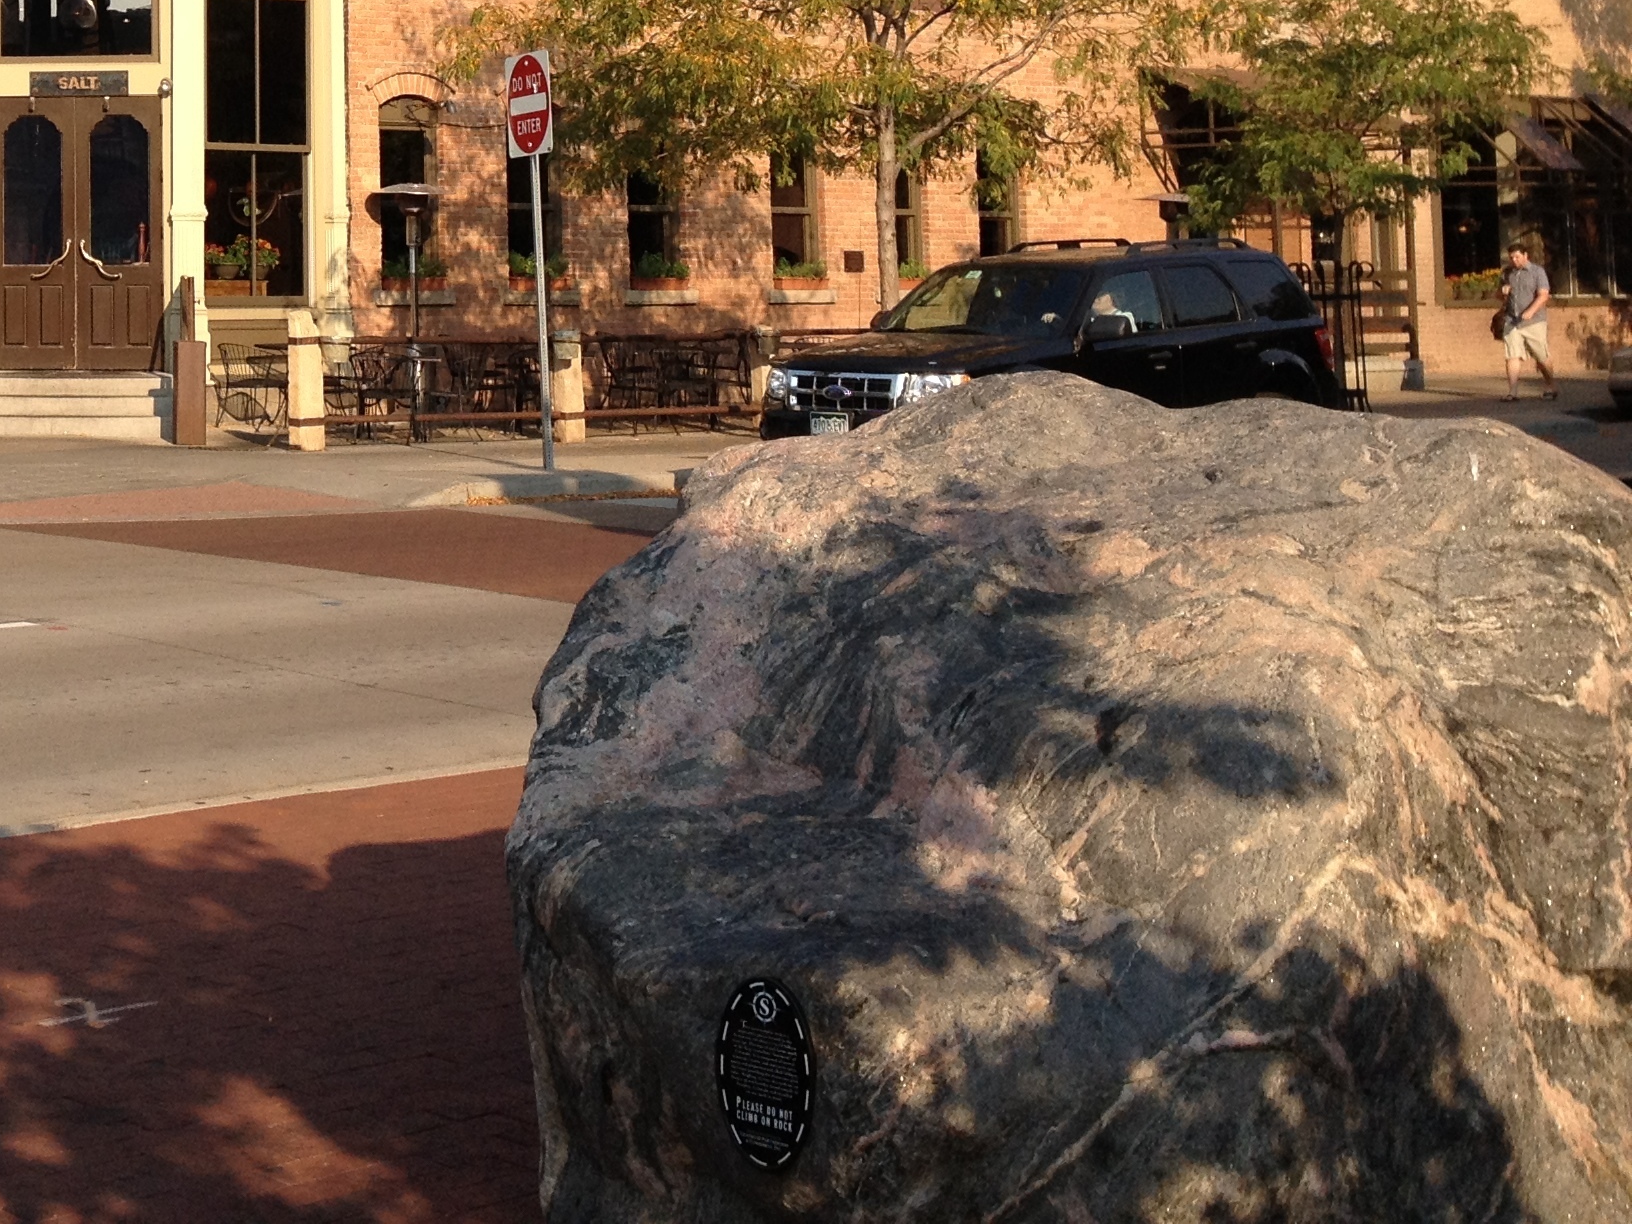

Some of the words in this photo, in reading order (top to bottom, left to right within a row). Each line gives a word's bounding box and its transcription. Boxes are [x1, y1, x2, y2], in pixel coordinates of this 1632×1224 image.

[58, 76, 100, 90] SALT
[512, 76, 523, 92] DO
[526, 72, 542, 90] NOT
[517, 117, 541, 136] ENTER
[736, 1095, 763, 1114] PLEASE
[766, 1105, 776, 1117] DO
[779, 1108, 793, 1121] NOT
[736, 1109, 758, 1124] CLIMB
[760, 1115, 771, 1127] ON
[773, 1118, 793, 1133] ROCK
